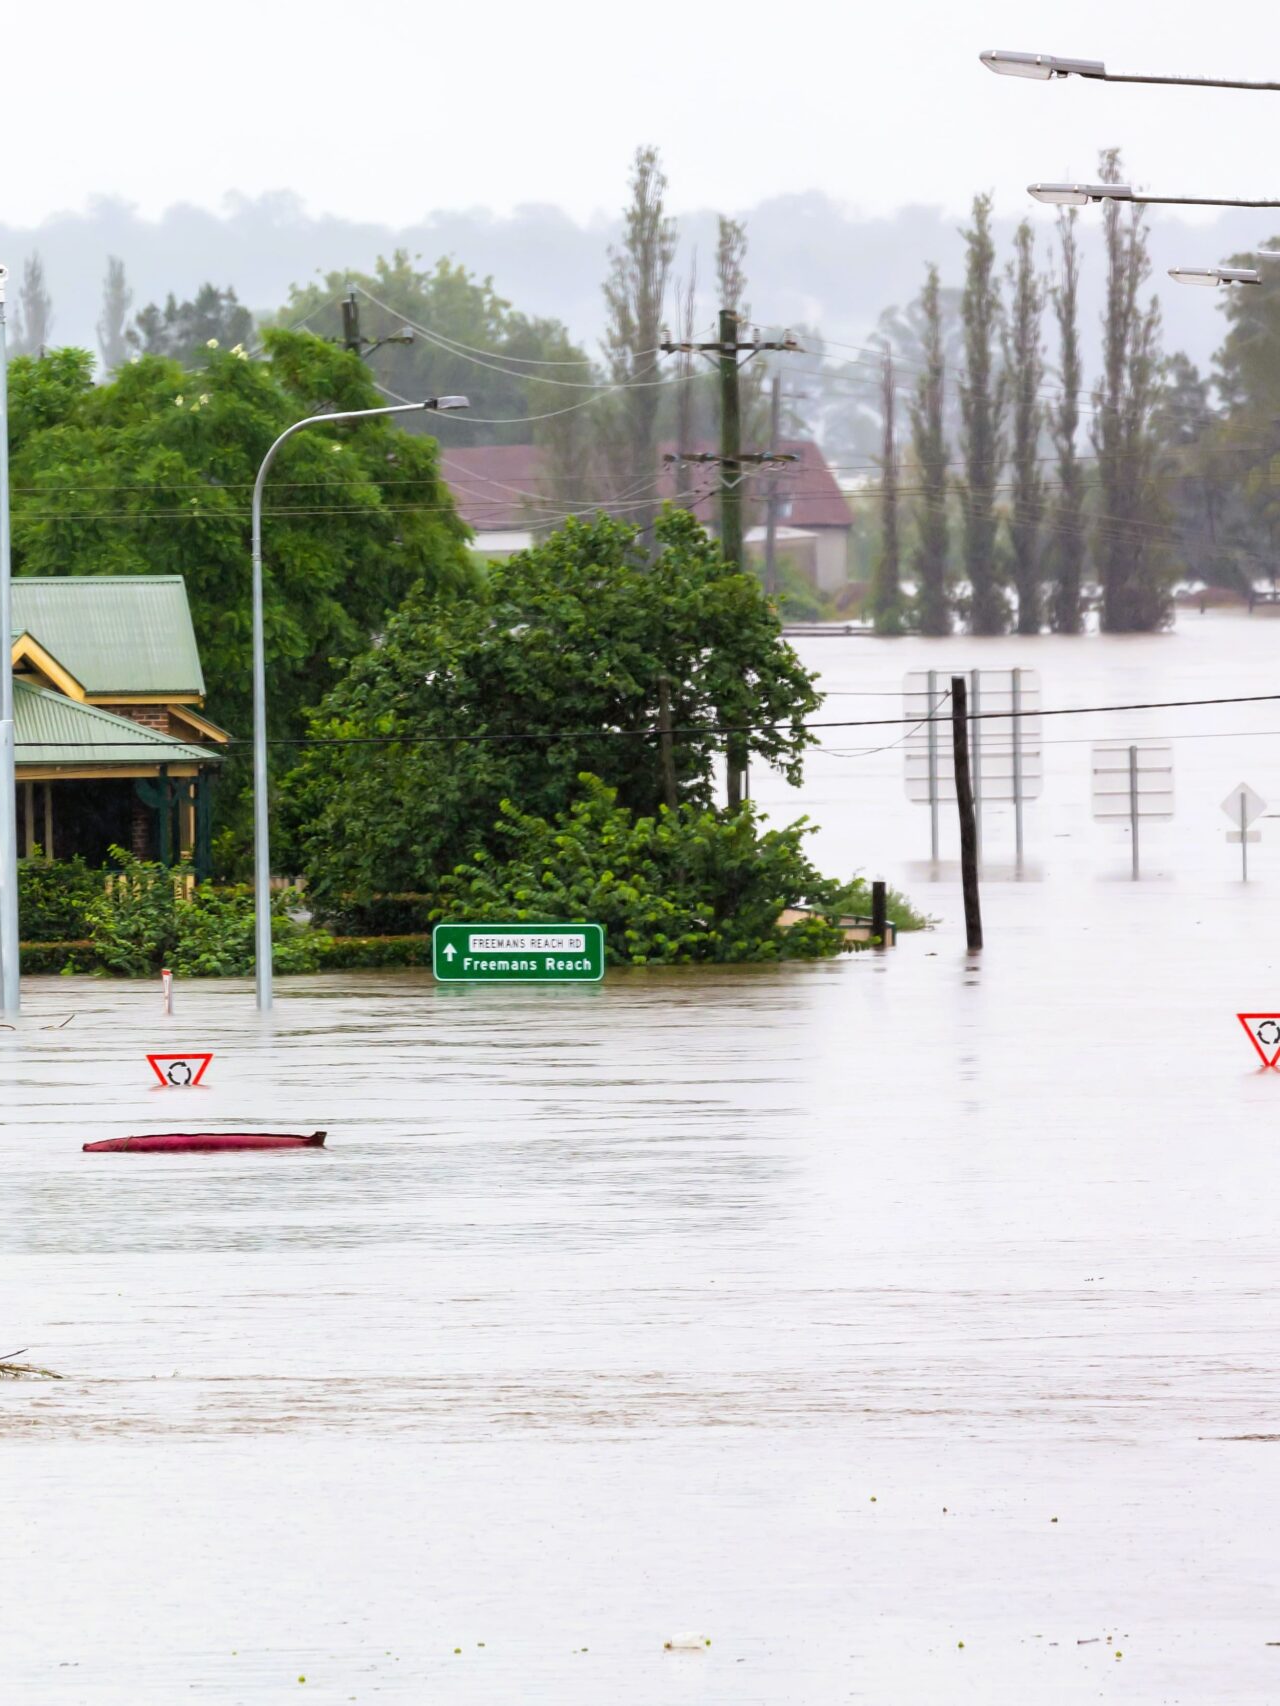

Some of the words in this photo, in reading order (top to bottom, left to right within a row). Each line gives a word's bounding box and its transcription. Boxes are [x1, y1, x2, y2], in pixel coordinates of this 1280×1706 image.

[472, 938, 526, 949] FREEMANS
[530, 938, 564, 949] REACH
[569, 938, 582, 949] RD
[463, 957, 537, 971] Freemans
[545, 957, 592, 971] Reach
